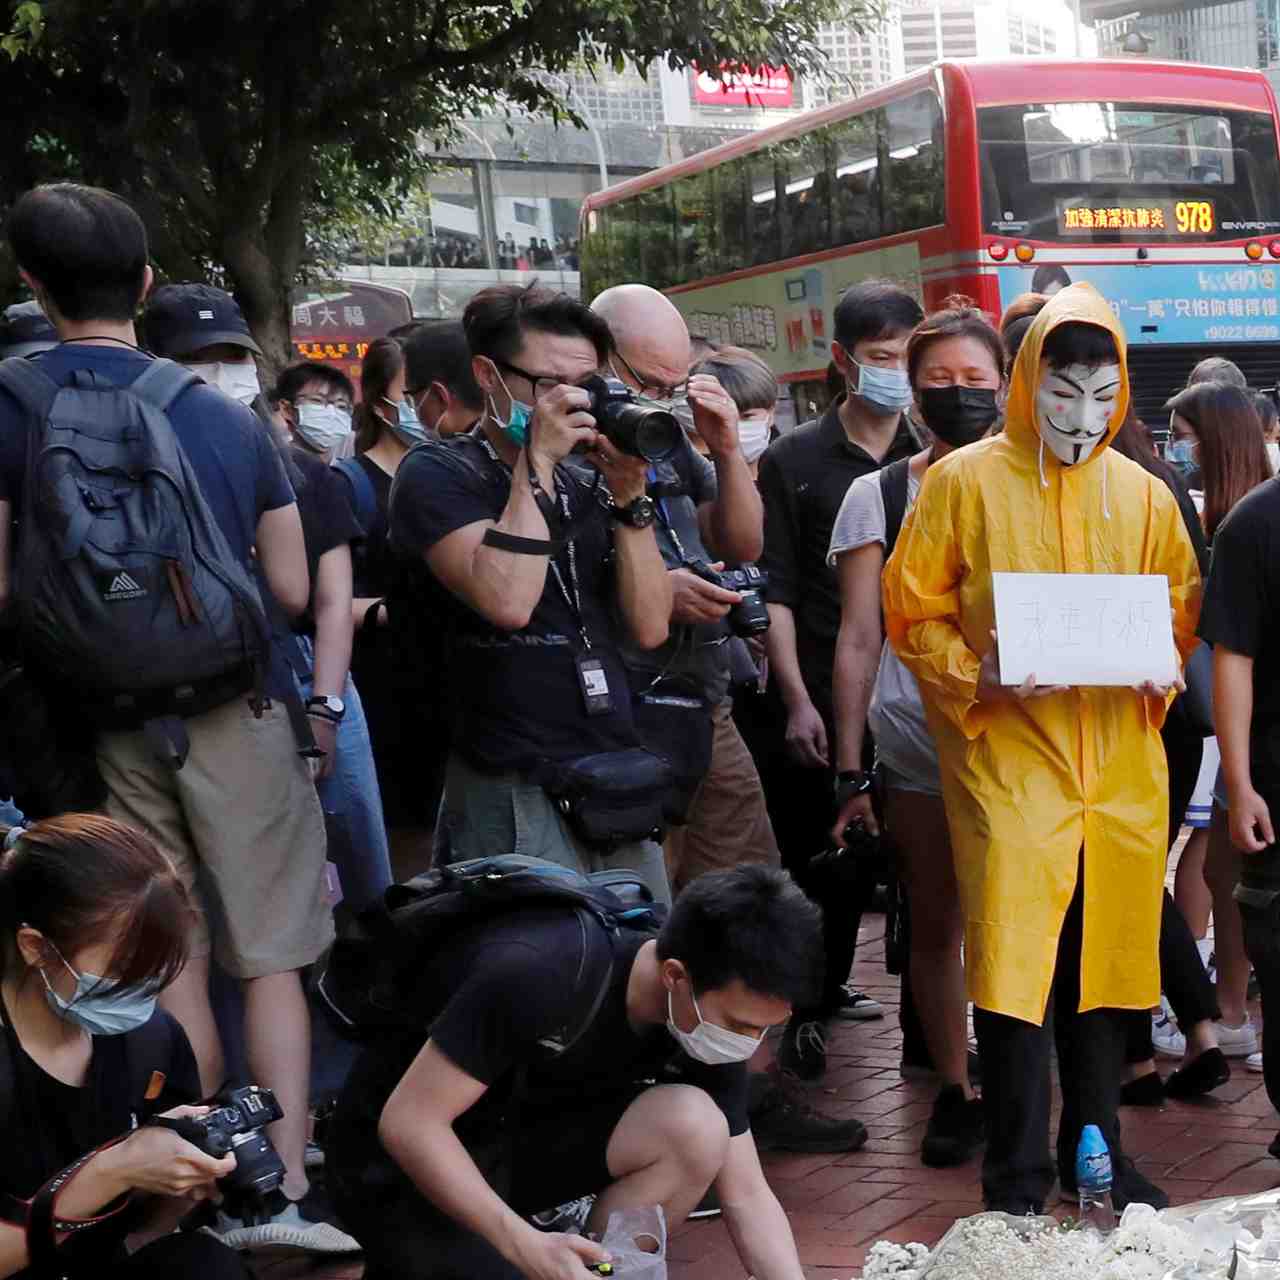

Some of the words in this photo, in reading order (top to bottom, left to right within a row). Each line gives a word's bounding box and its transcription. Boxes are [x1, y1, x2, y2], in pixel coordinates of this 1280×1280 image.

[1063, 208, 1166, 229] 加強清潔抗肺炎
[1175, 201, 1212, 233] 978
[292, 305, 365, 327] 周大福
